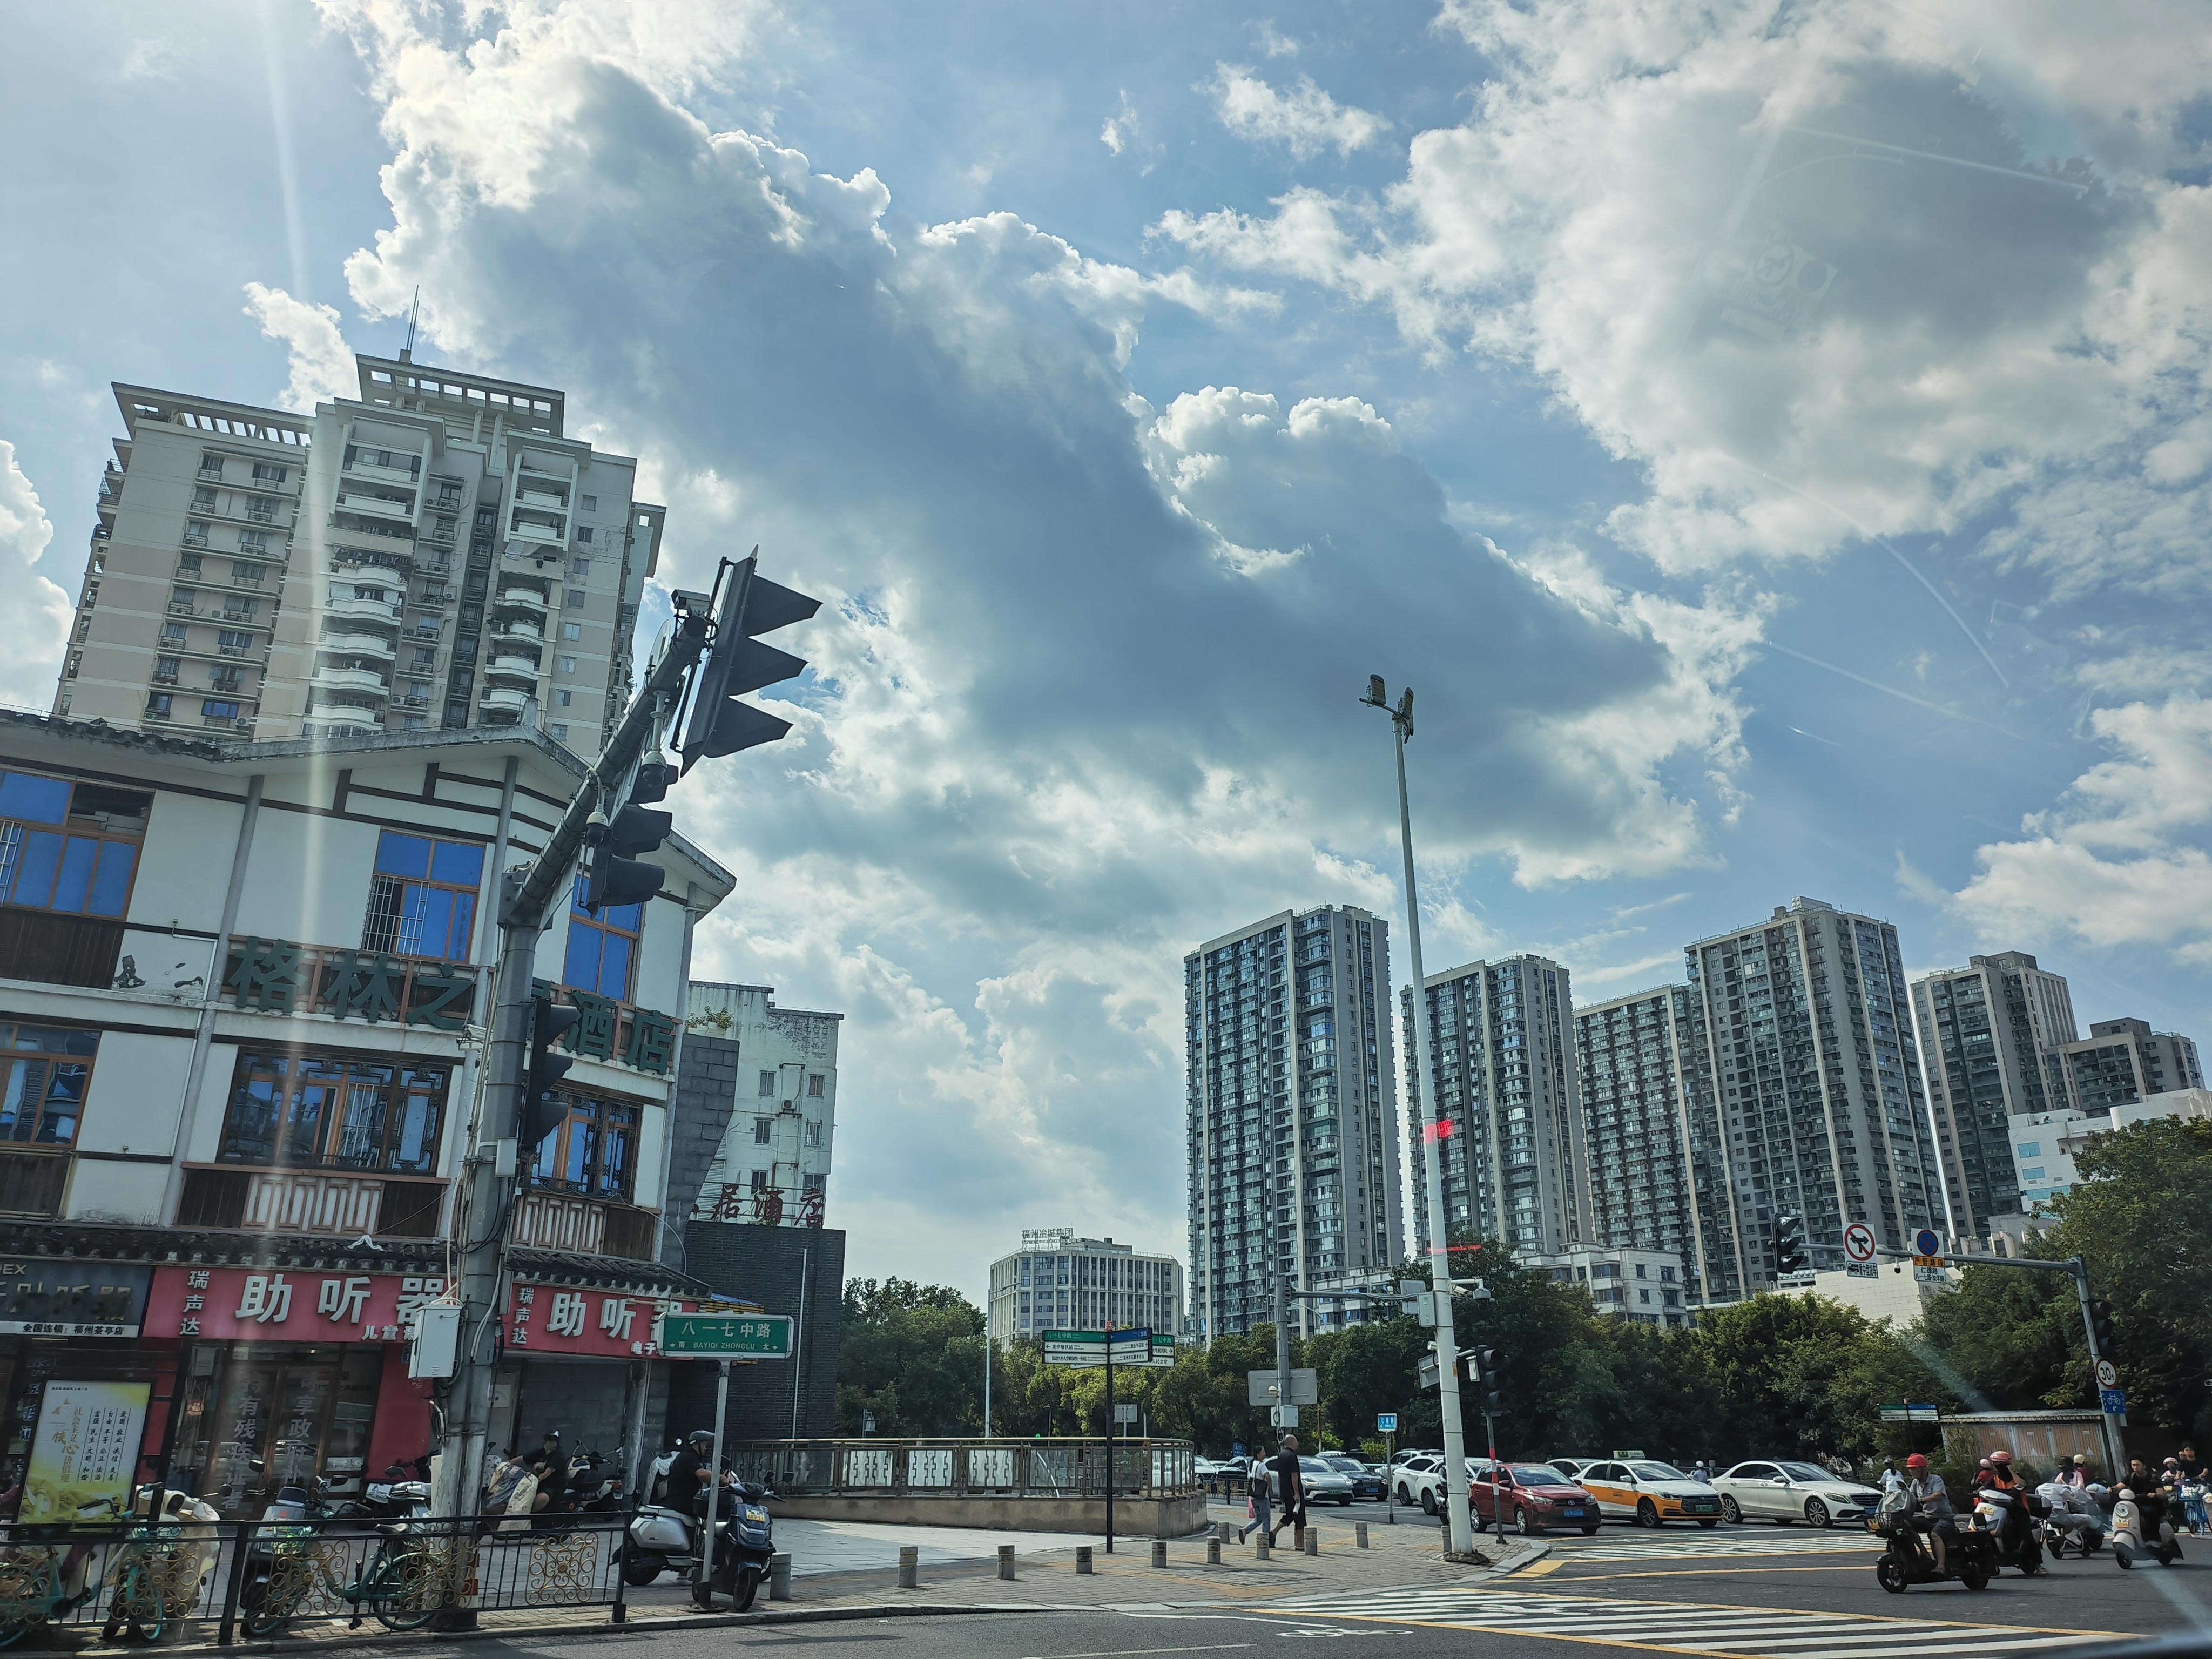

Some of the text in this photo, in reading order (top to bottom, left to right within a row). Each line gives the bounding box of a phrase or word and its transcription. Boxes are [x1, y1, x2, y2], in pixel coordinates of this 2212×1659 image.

[692, 1184, 825, 1226] 居酒店
[0, 1264, 26, 1275] EX
[179, 1270, 211, 1336] 瑞声达
[510, 1287, 535, 1345] 瑞声达
[681, 1320, 771, 1338] 八一七中路
[2100, 1367, 2115, 1381] 30t
